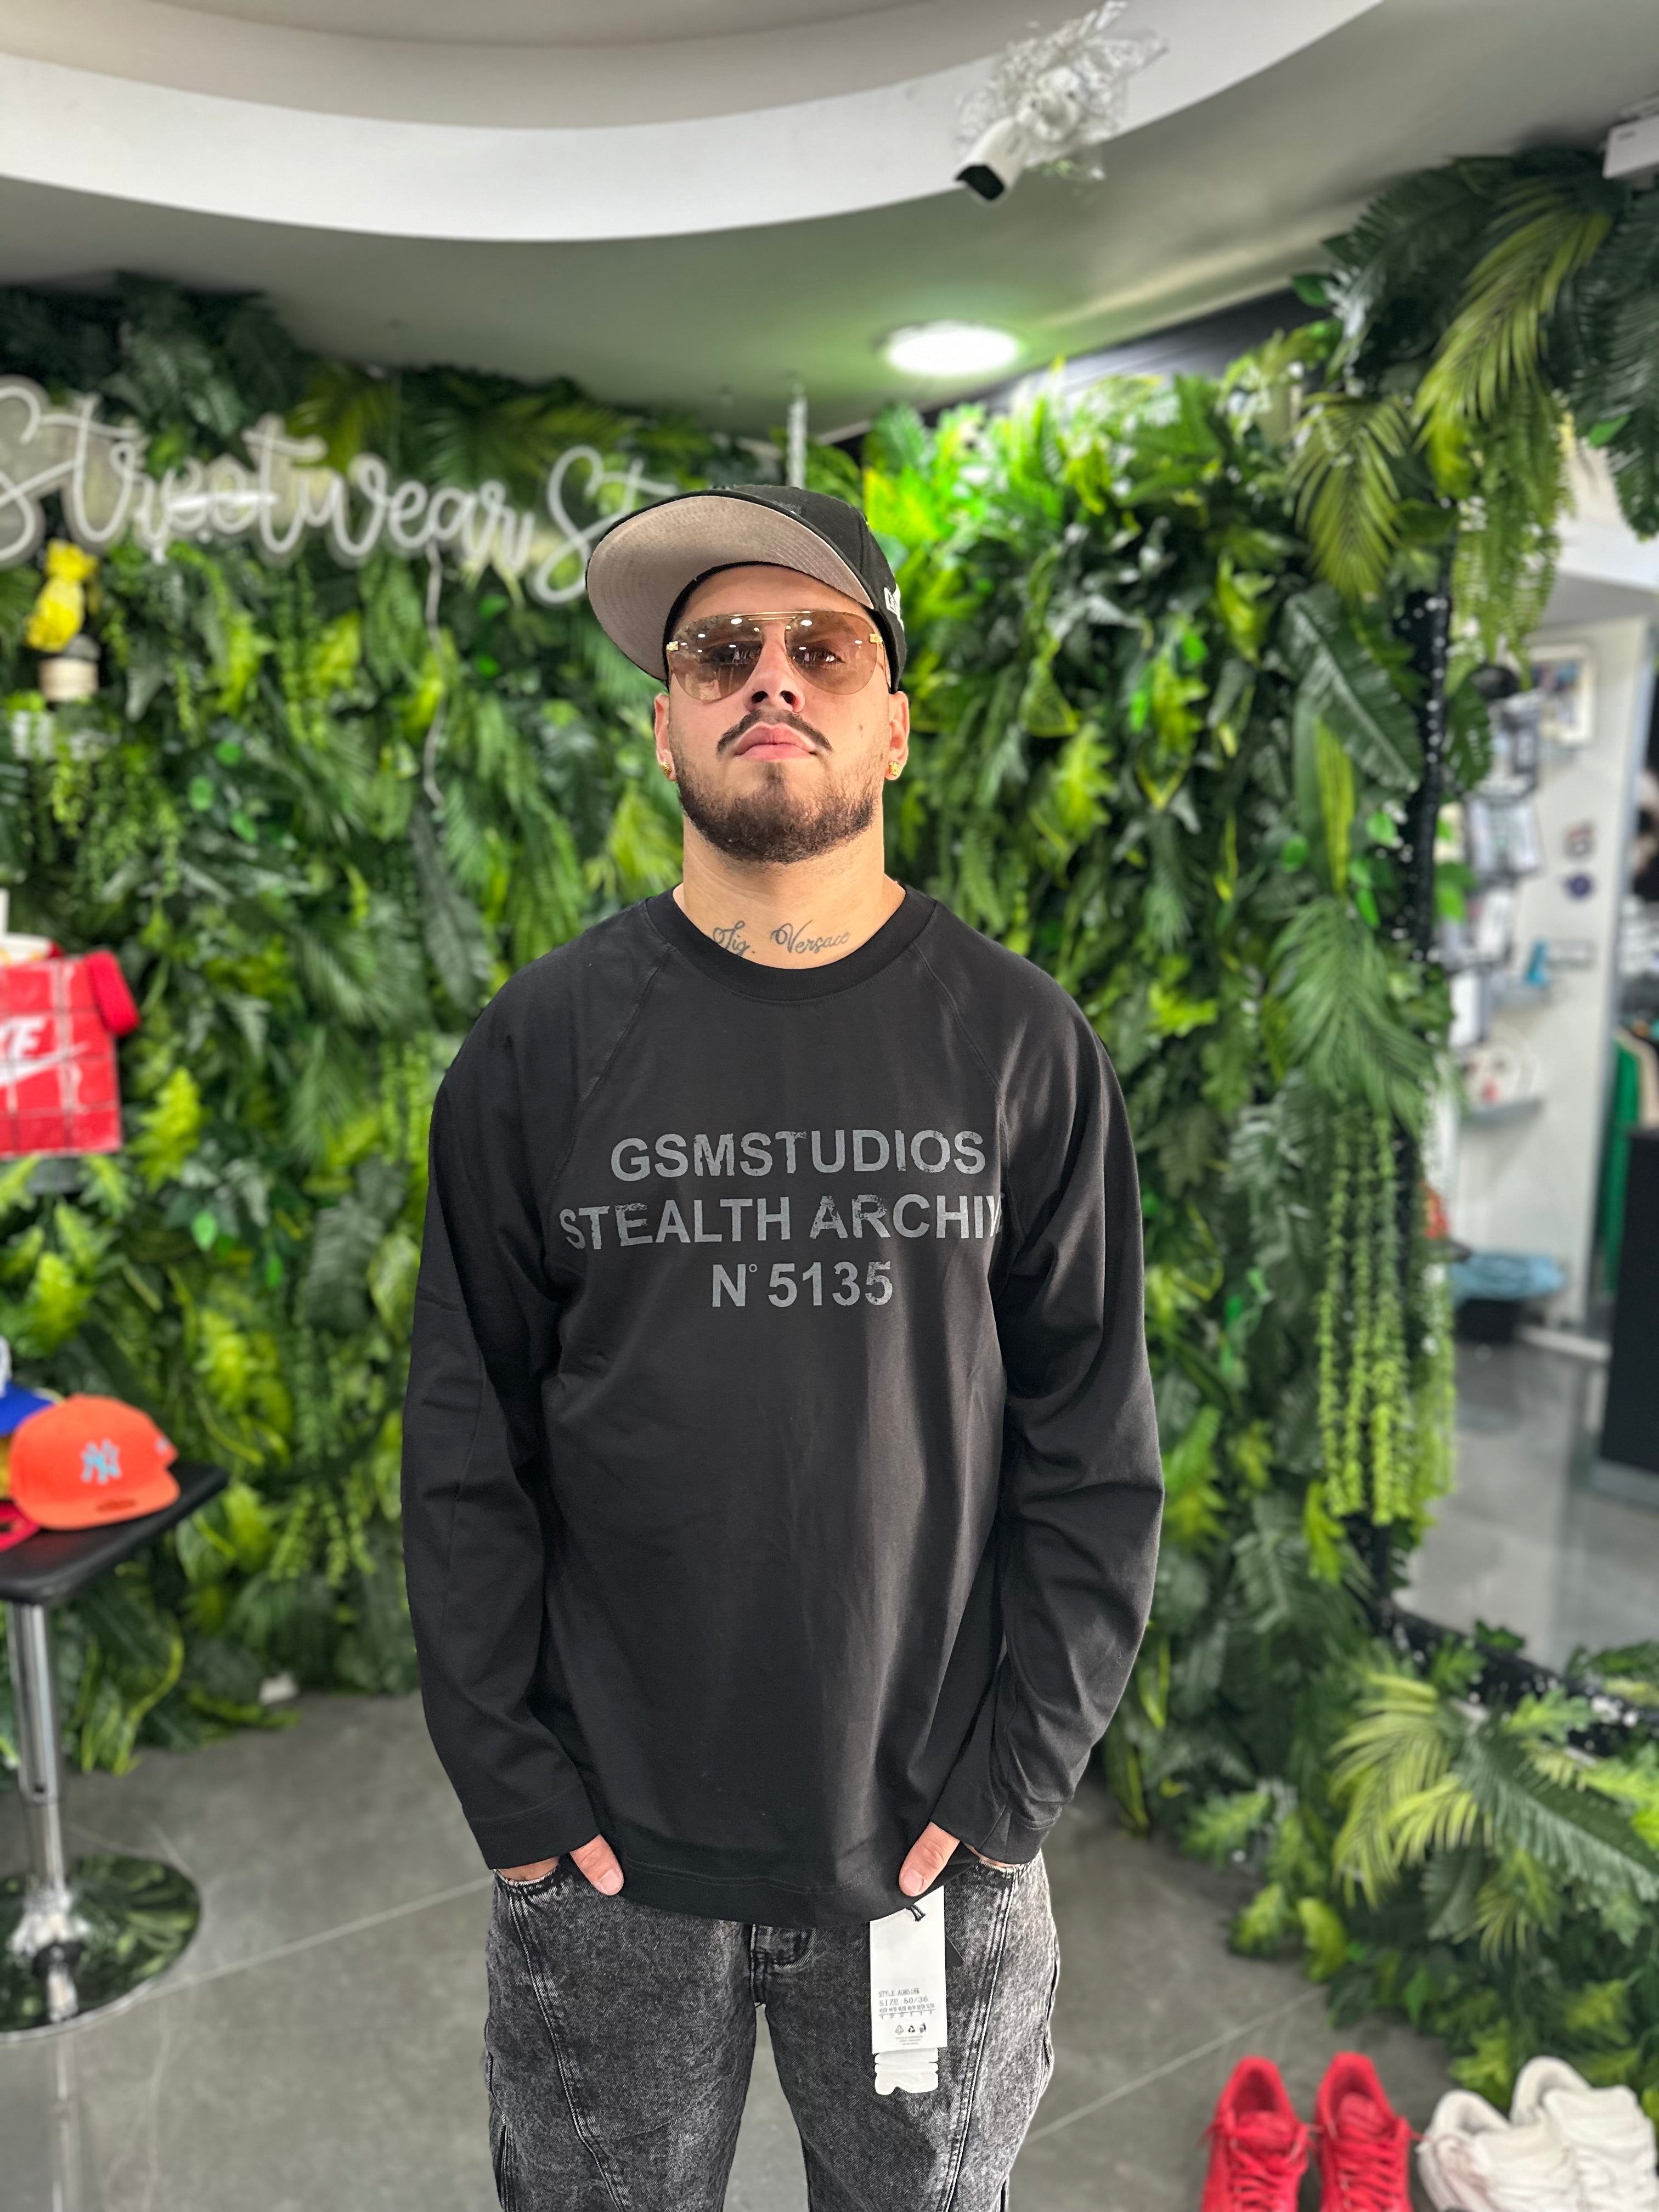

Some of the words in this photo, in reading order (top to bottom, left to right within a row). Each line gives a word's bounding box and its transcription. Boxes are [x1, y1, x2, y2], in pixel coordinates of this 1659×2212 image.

[770, 919, 850, 954] Versace
[611, 1129, 986, 1182] GSMSTUDIOS
[558, 1196, 791, 1250] STEALTH
[809, 1192, 1005, 1240] ARCHIV
[768, 1260, 893, 1308] 5135
